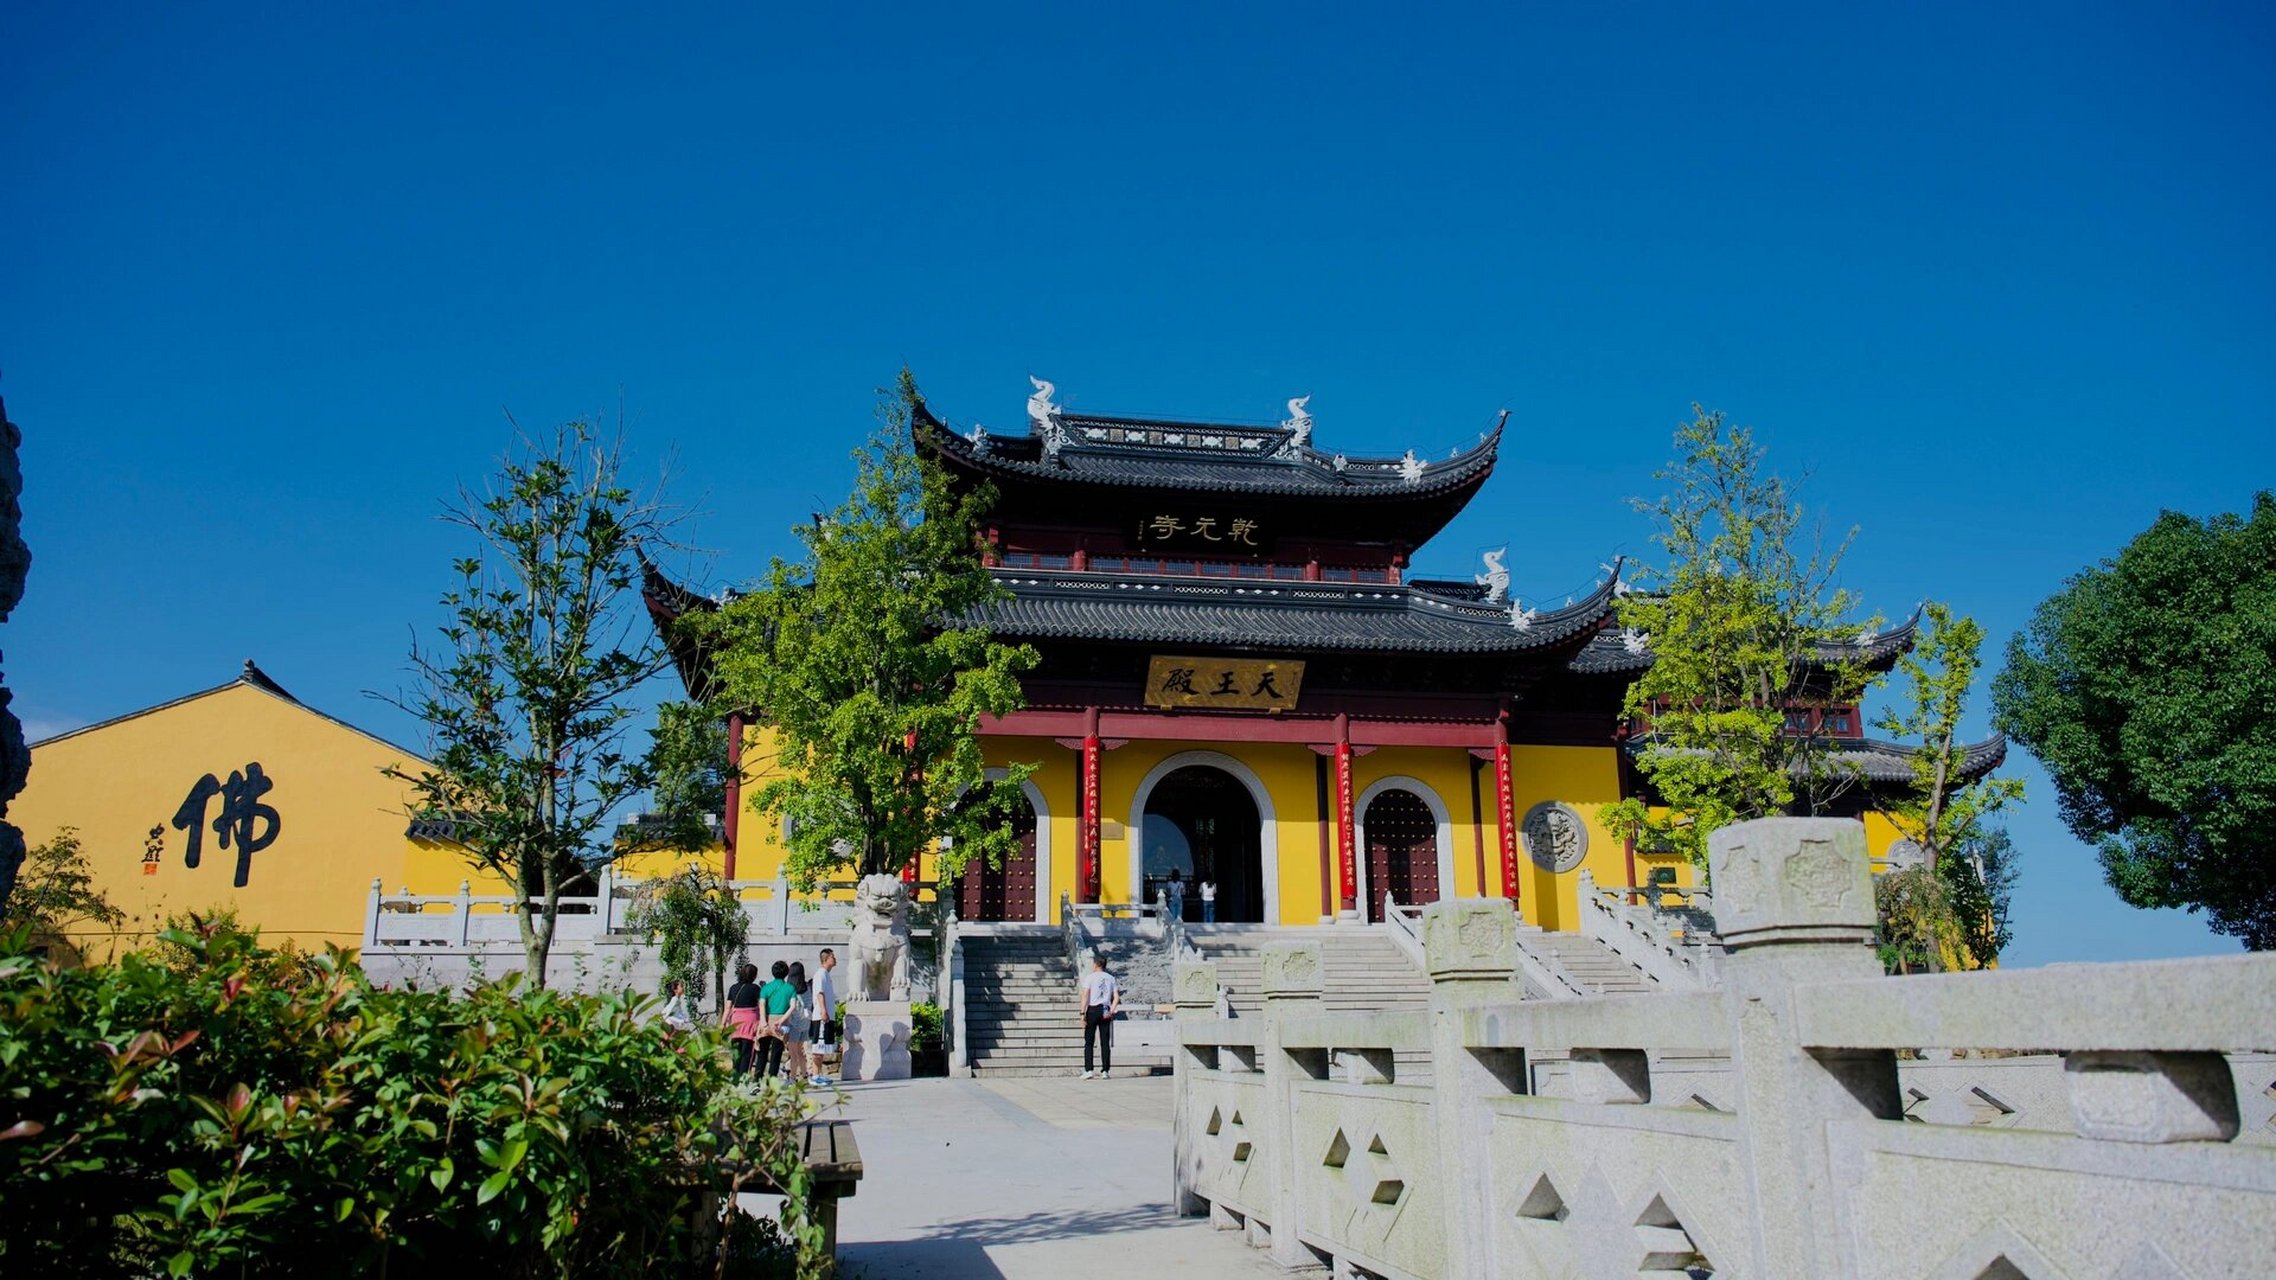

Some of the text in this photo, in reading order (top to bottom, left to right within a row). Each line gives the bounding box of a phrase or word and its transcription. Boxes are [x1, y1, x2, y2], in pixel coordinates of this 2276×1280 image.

[1149, 515, 1258, 545] 乾元寺
[1161, 668, 1283, 698] 天王殿
[172, 762, 281, 888] 佛
